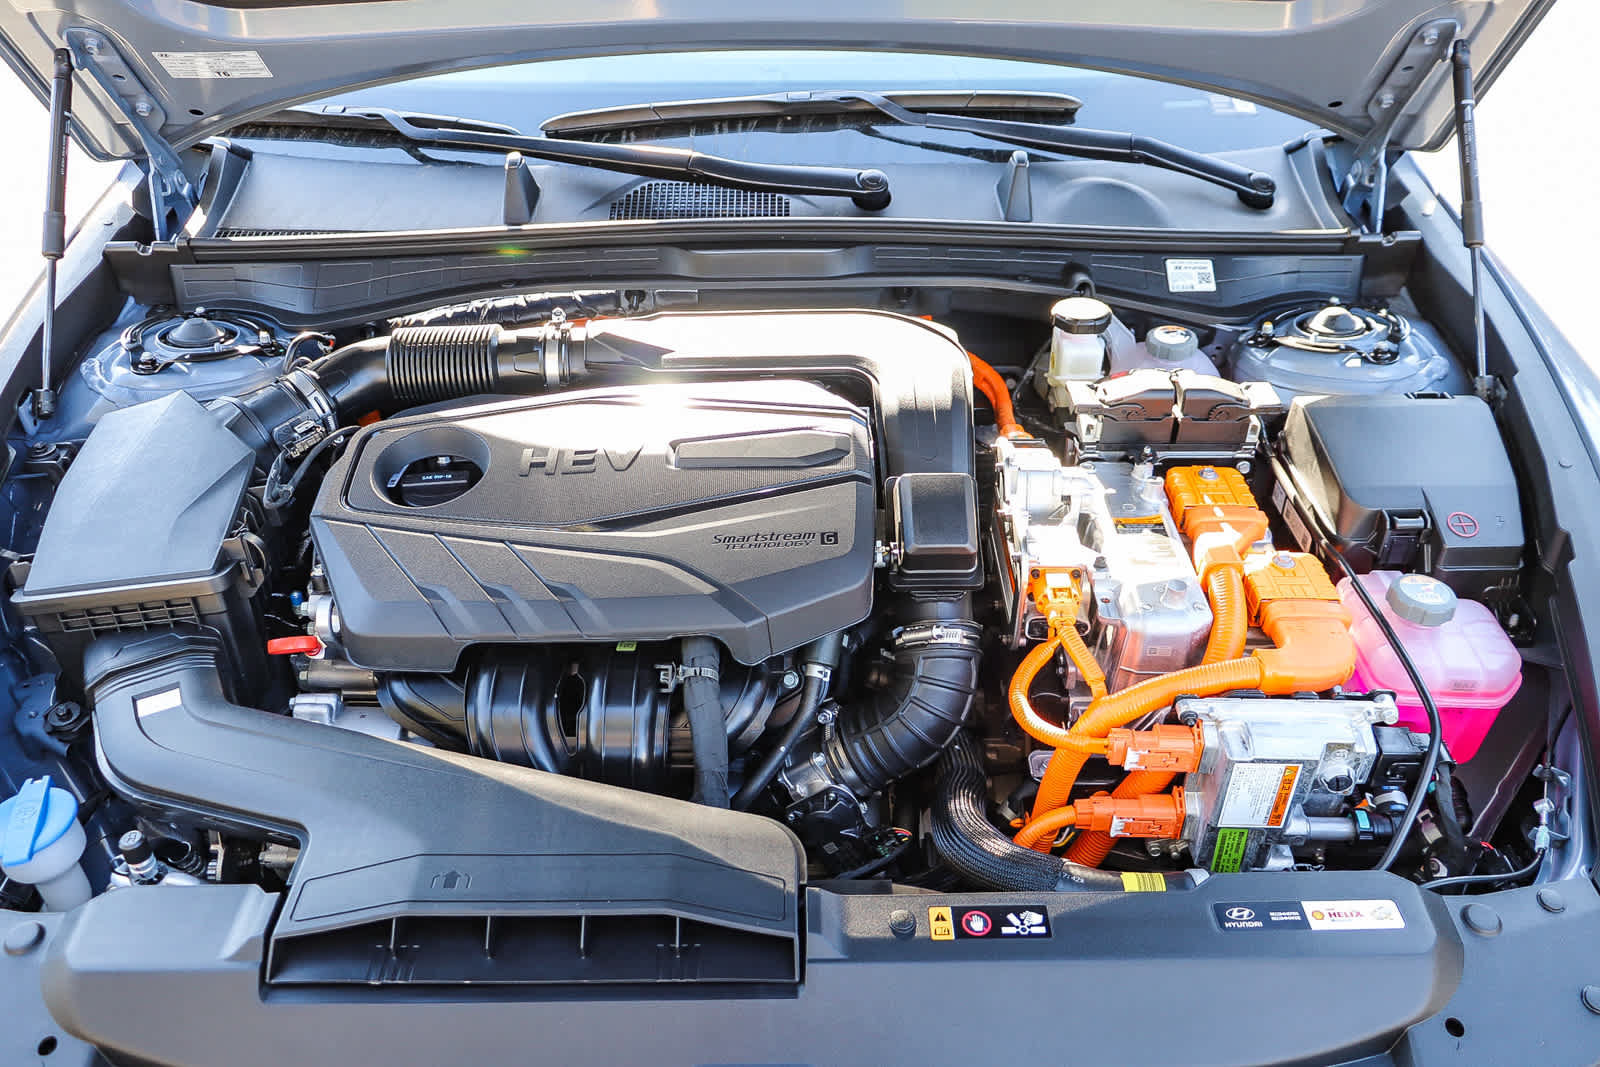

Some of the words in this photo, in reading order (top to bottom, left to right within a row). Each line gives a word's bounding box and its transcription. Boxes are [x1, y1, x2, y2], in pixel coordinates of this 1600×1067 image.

[519, 443, 644, 477] HEV
[713, 532, 816, 545] Smartstream
[725, 541, 812, 550] TECHNOLOGY
[1328, 911, 1364, 919] HELIX
